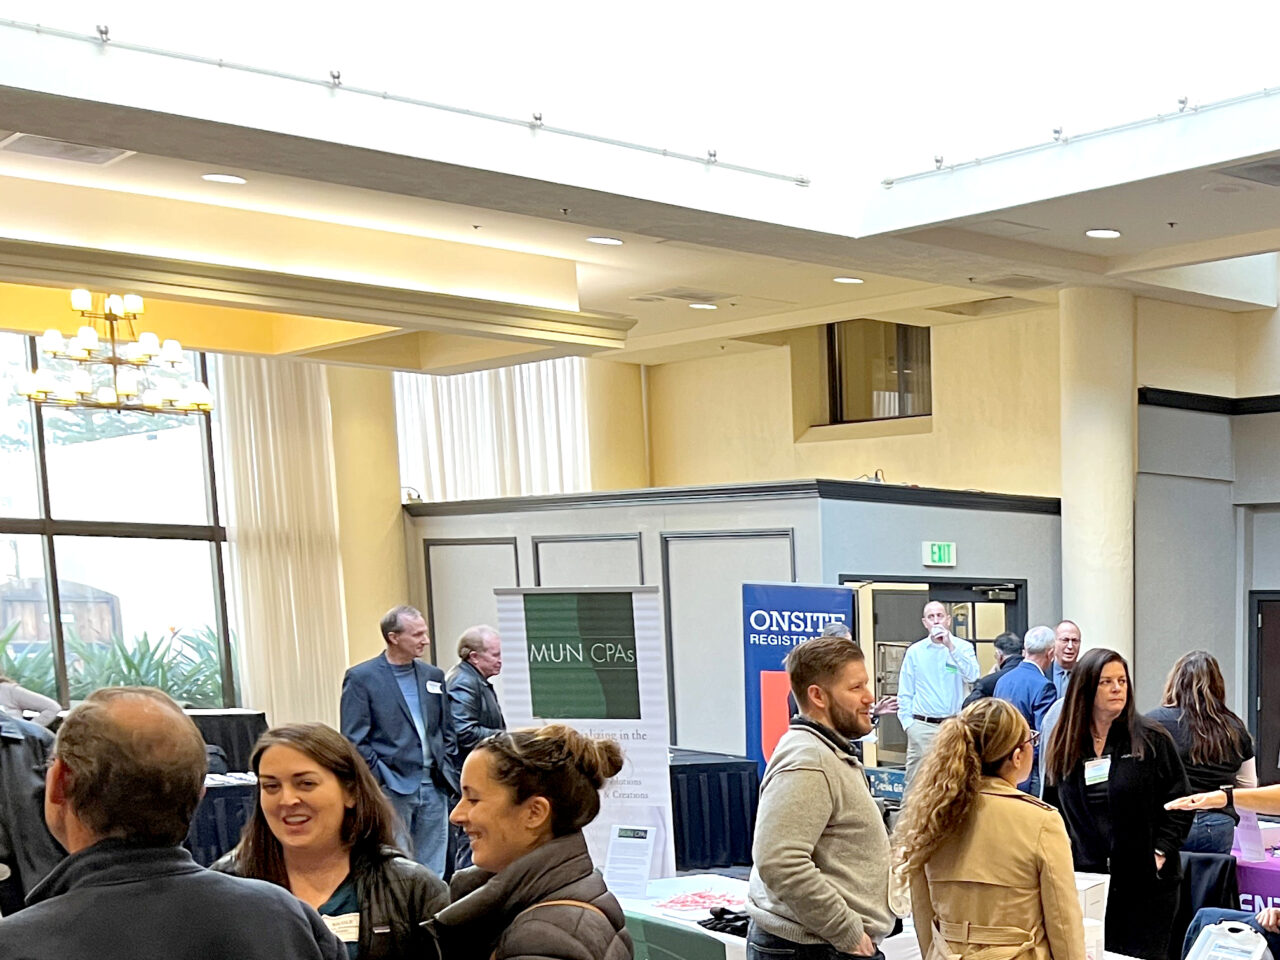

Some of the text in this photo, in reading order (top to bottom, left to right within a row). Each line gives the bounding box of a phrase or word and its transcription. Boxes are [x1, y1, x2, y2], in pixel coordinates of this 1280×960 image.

[930, 543, 952, 563] EXIT
[749, 609, 846, 632] ONSITE
[590, 643, 635, 662] CPAs
[620, 730, 629, 740] in
[632, 729, 647, 740] the
